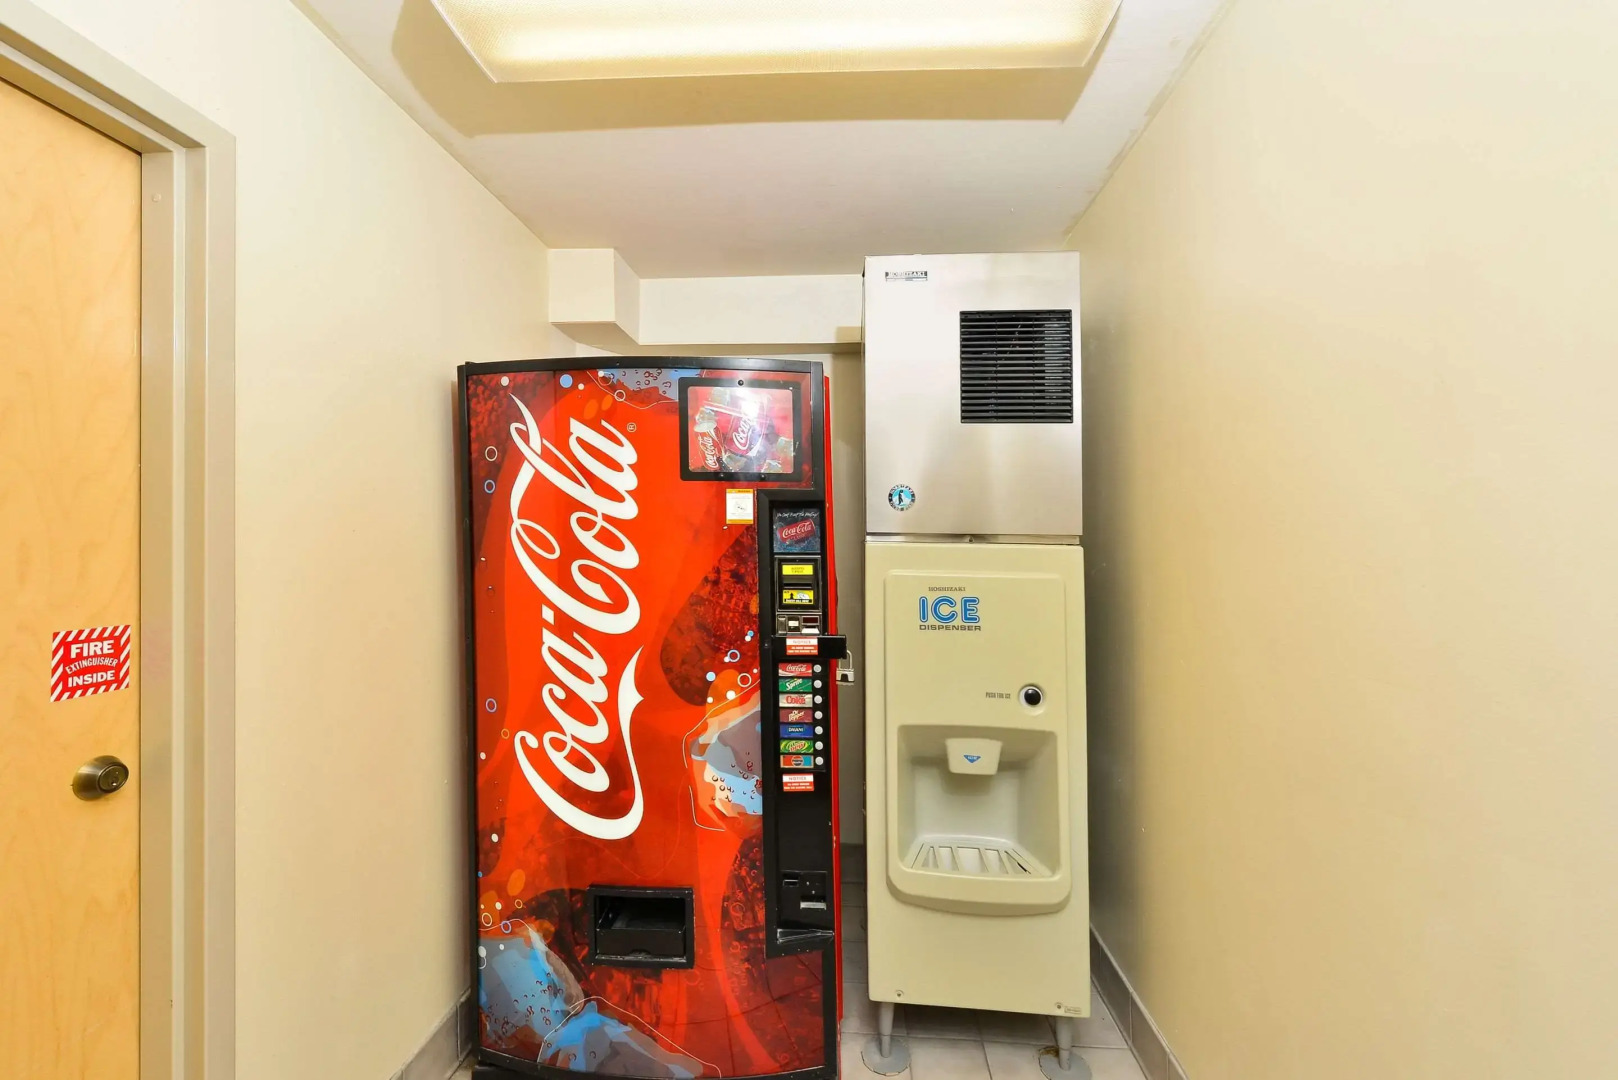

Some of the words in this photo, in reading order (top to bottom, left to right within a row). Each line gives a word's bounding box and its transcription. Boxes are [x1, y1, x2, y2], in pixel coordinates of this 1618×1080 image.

[782, 521, 812, 538] Coca-Cola
[508, 391, 645, 840] Coca-Cola
[919, 595, 980, 624] ICE
[70, 639, 115, 659] FIRE
[65, 656, 118, 674] EXTINGUISHER
[67, 670, 115, 688] INSIDE
[786, 678, 803, 690] Sprite
[785, 695, 806, 705] Coke
